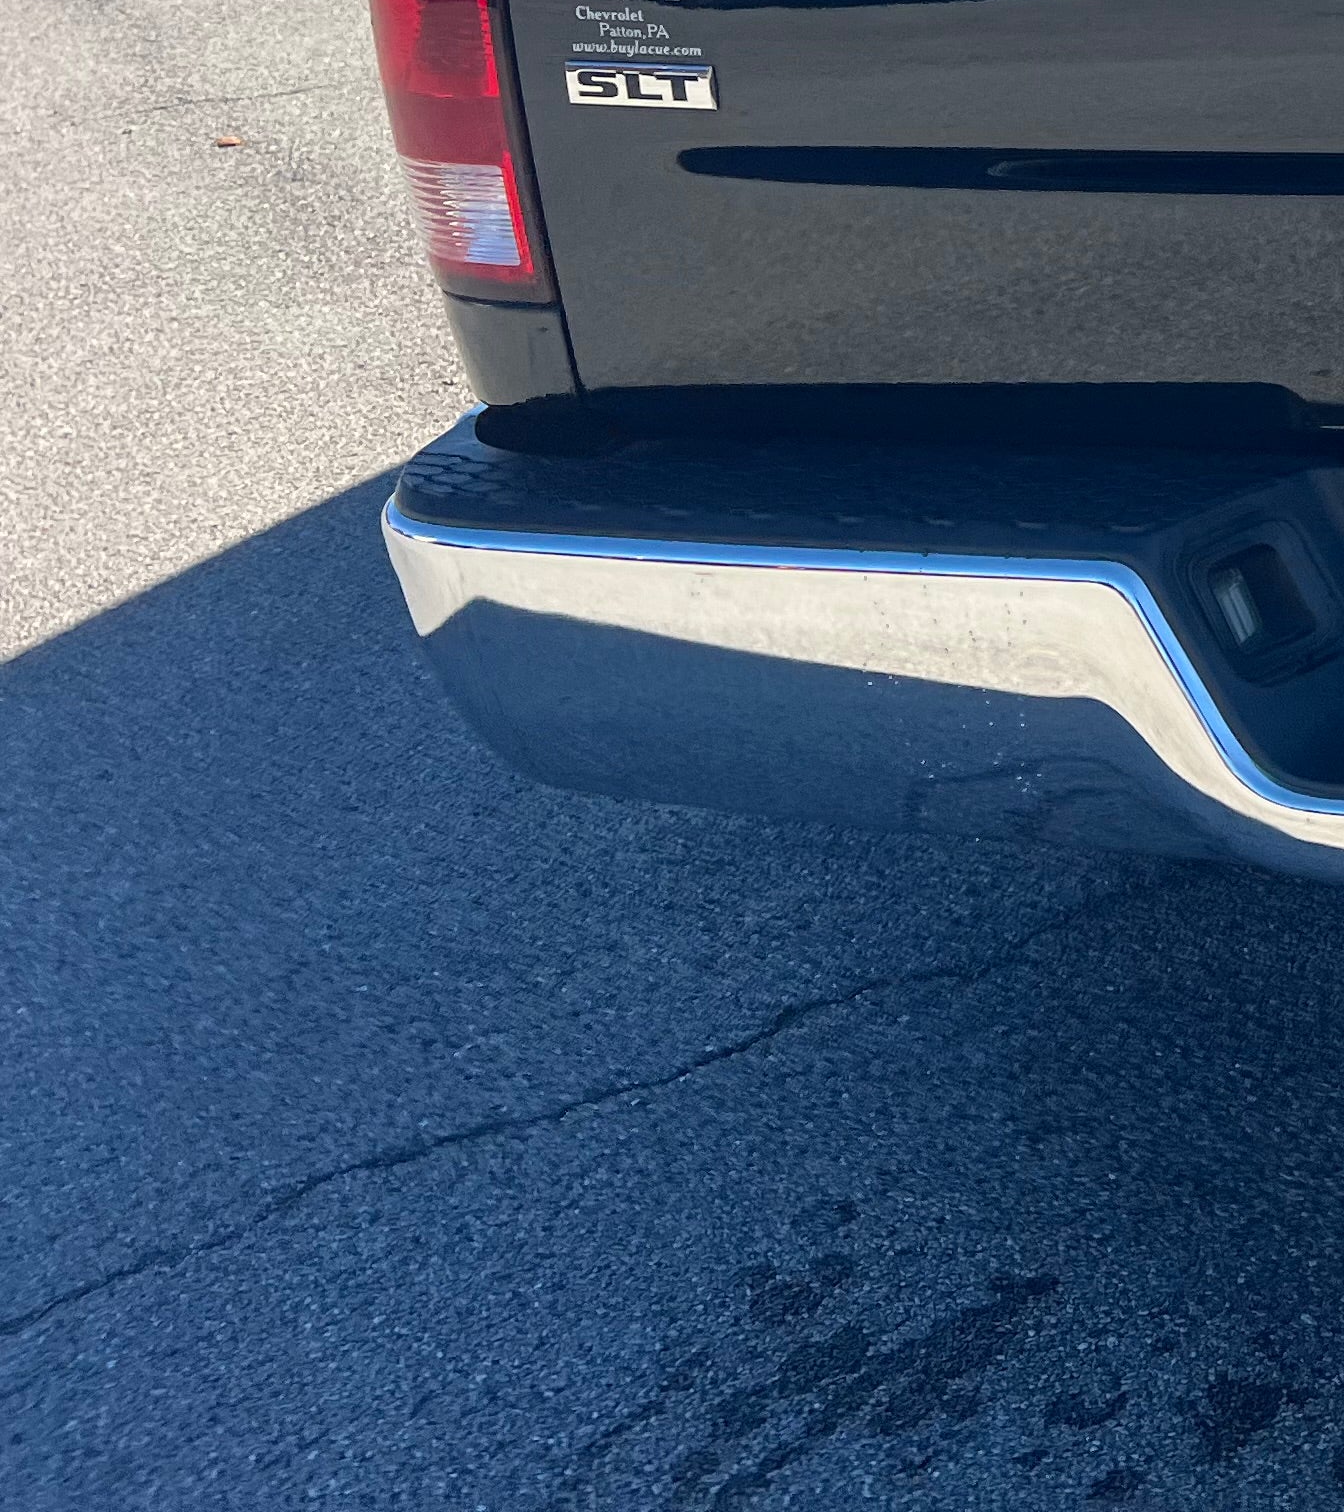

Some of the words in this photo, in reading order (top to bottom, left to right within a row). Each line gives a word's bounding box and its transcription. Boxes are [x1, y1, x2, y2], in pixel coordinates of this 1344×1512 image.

[575, 5, 644, 22] Chevrolet
[572, 40, 702, 58] www.buylacue.com
[577, 70, 699, 102] SLT
